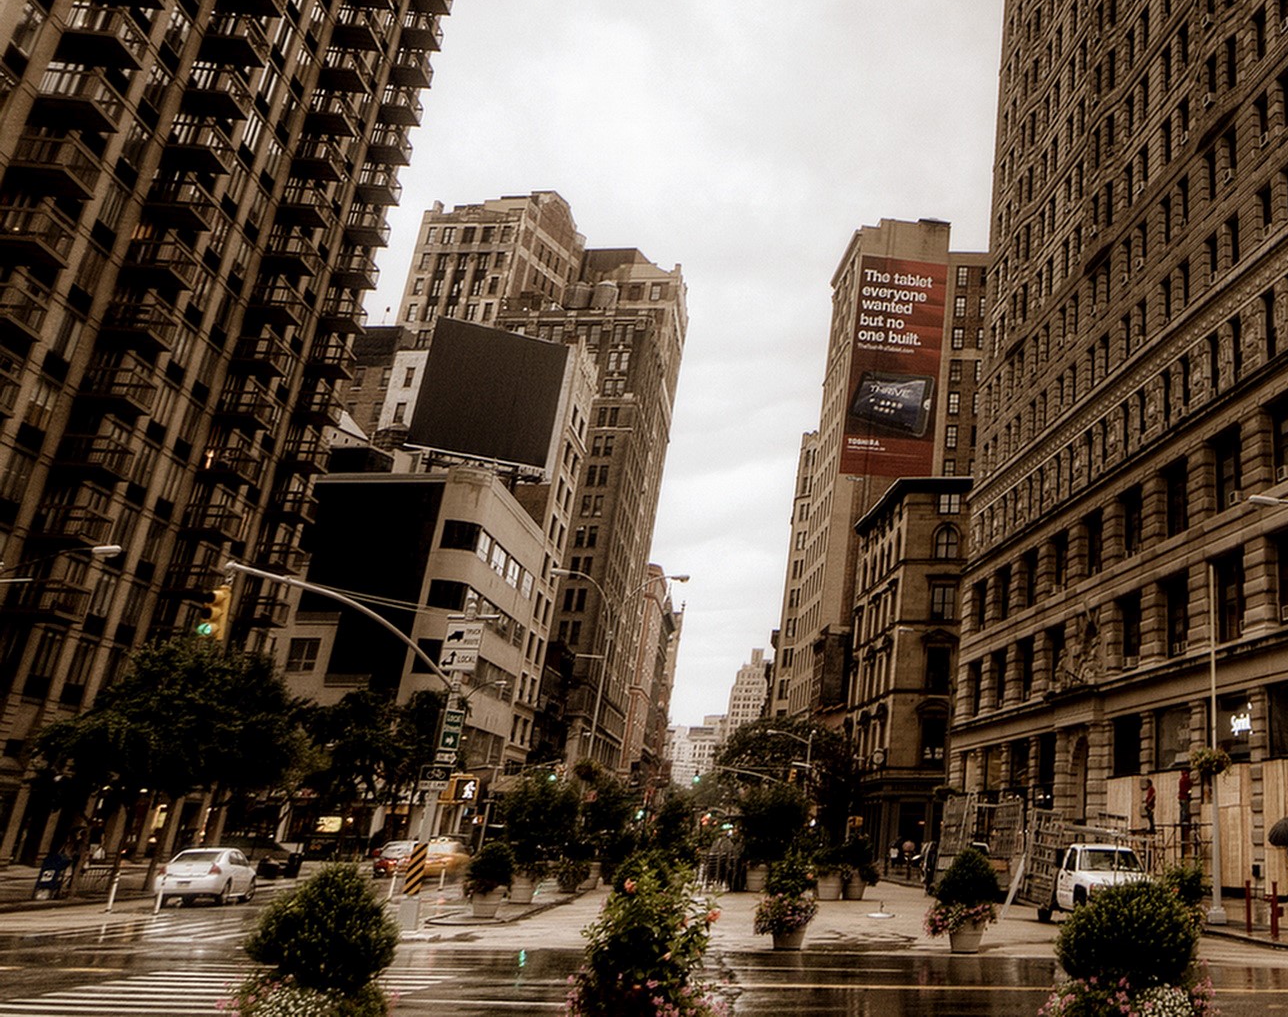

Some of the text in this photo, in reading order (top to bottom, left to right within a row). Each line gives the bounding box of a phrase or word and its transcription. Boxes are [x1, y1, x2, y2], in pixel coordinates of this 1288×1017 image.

[864, 269, 933, 288] The tablet
[862, 286, 928, 302] everyone
[862, 300, 913, 315] wanted
[860, 313, 905, 329] but no
[858, 330, 921, 345] one built.
[457, 655, 476, 663] LOCAL
